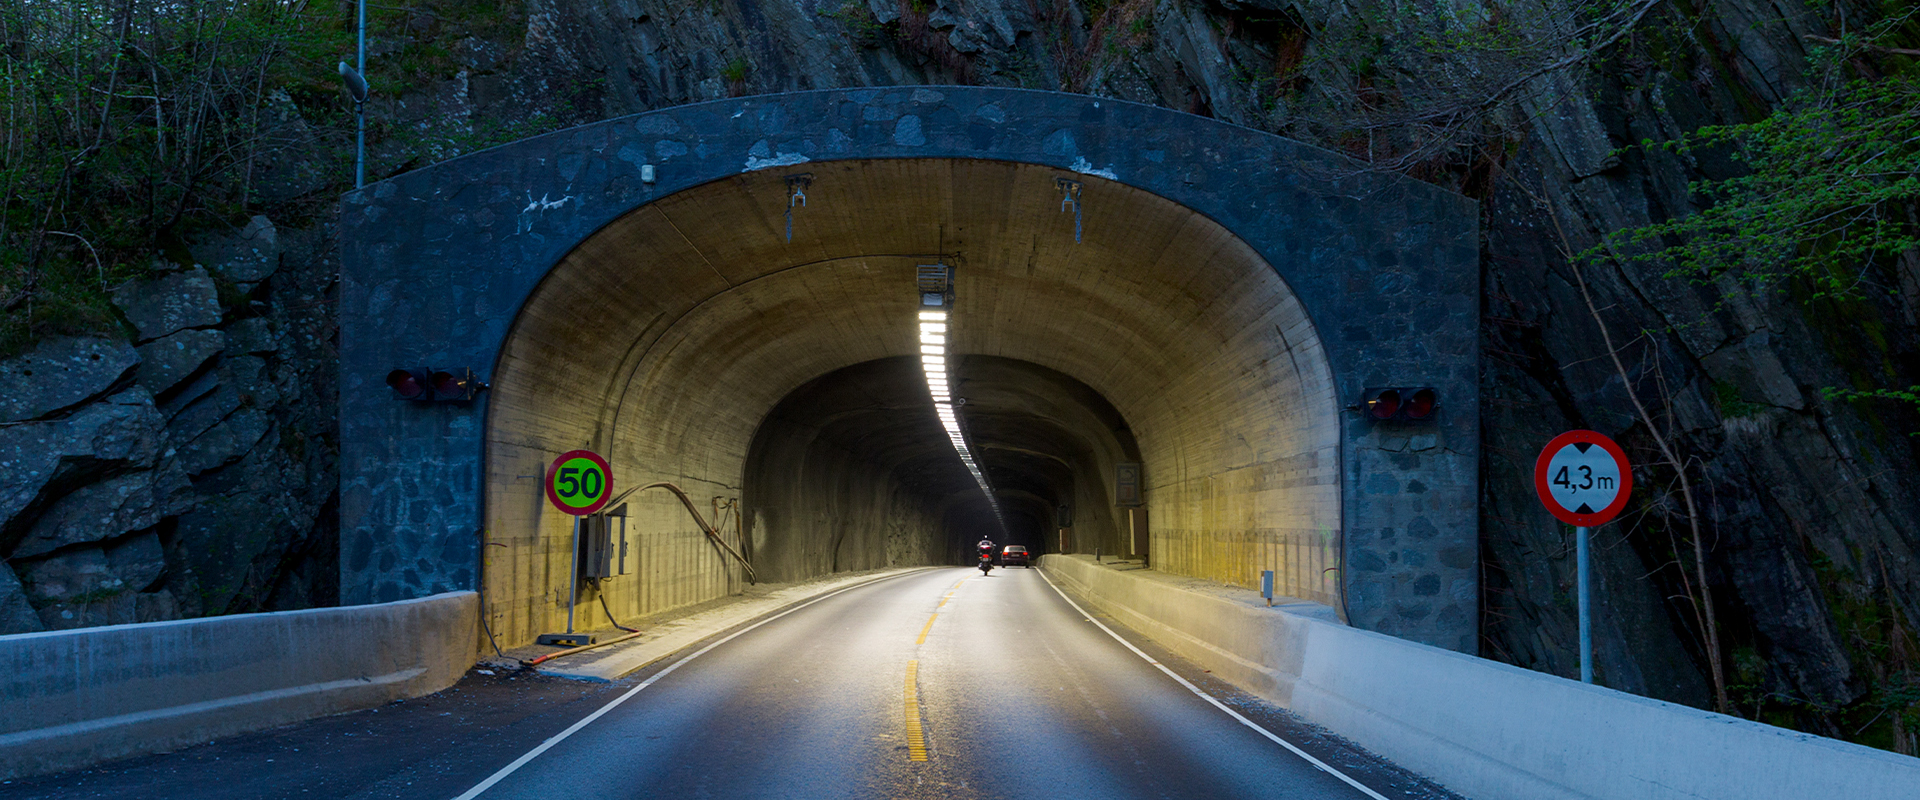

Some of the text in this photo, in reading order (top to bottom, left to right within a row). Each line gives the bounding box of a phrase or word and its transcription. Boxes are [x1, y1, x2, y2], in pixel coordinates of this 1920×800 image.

[558, 467, 602, 499] 50
[1553, 465, 1614, 494] 4,3 m
